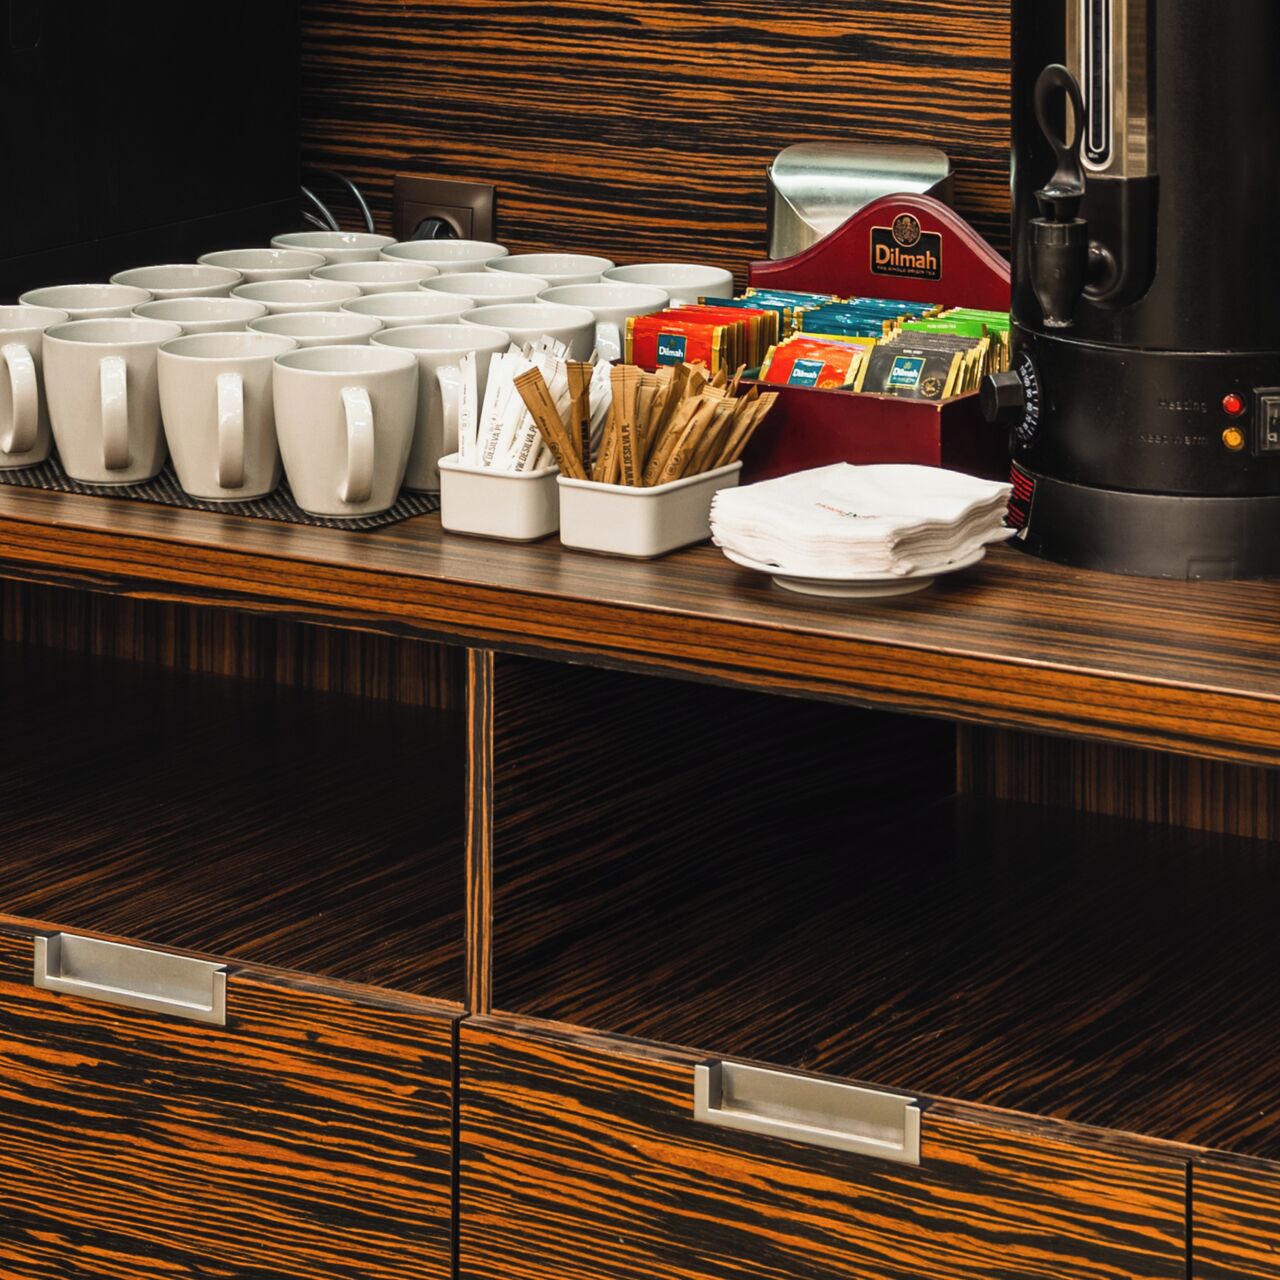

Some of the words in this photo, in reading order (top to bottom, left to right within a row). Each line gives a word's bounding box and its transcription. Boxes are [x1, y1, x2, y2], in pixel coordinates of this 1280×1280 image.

[875, 244, 937, 270] Dilmah
[658, 346, 684, 358] Dilmah
[792, 368, 818, 379] Dilmah
[892, 367, 919, 379] Dilmah
